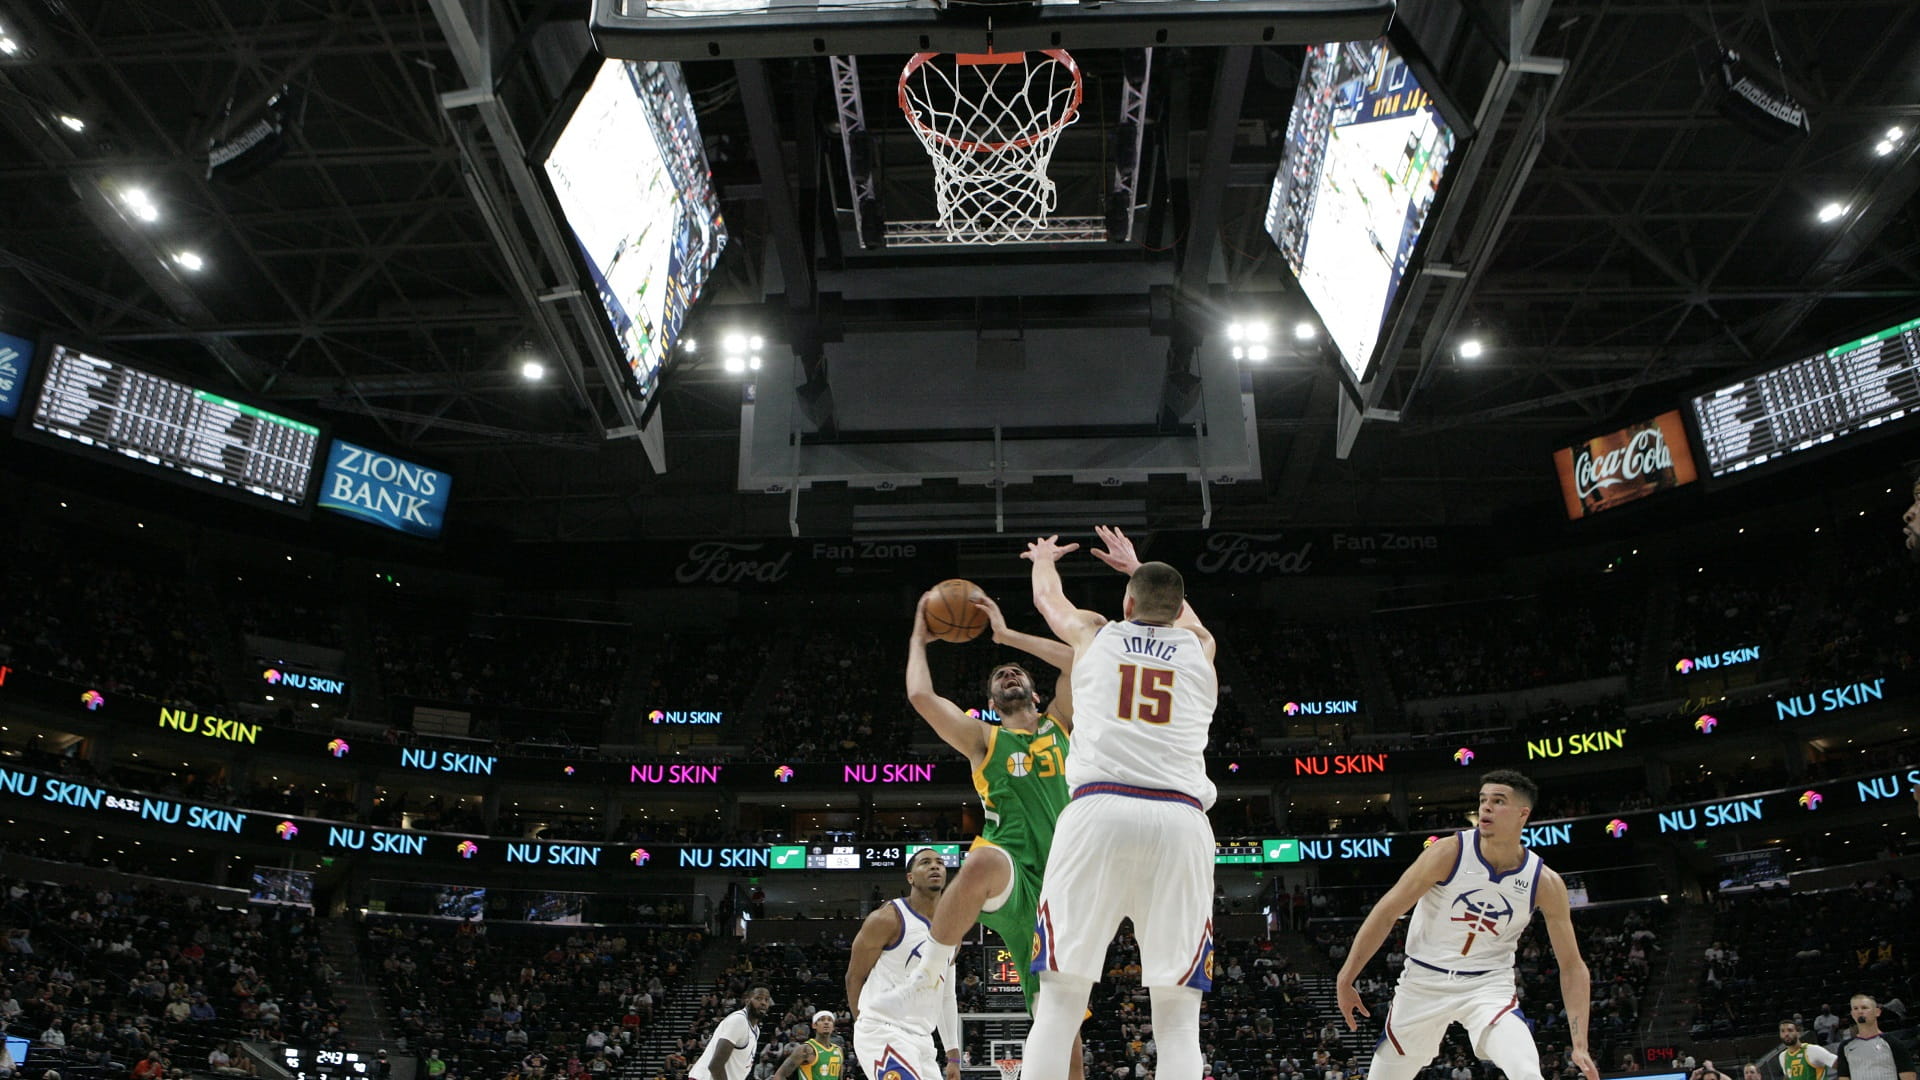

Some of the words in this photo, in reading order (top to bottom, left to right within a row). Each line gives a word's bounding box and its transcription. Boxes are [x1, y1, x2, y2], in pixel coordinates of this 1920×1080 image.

[336, 444, 437, 496] ZIONS
[1575, 429, 1673, 499] Coca-Cola
[330, 473, 430, 527] BANK
[812, 543, 854, 559] Fan
[860, 542, 917, 558] Zone
[1196, 532, 1312, 573] Ford
[1332, 534, 1374, 550] Fan
[1380, 533, 1438, 549] Zone
[675, 542, 792, 583] Ford
[1123, 634, 1177, 661] JOKIĆ
[1695, 654, 1719, 670] NU
[1722, 646, 1759, 665] SKIN
[283, 673, 306, 688] NU
[308, 677, 344, 694] SKIN
[1117, 663, 1175, 726] 15
[1301, 702, 1322, 714] NU
[1325, 701, 1357, 713] SKIN
[1776, 694, 1816, 720] NU
[1822, 679, 1884, 710] SKIN
[160, 708, 198, 732] NU
[202, 716, 258, 744] SKIN
[666, 712, 687, 723] NU
[690, 712, 721, 723] SKIN
[1528, 738, 1563, 759] NU
[1569, 729, 1625, 754] SKIN
[402, 748, 436, 769] NU
[441, 752, 495, 774] SKIN
[631, 765, 663, 783] NU
[669, 765, 719, 783] SKIN
[845, 765, 876, 782] NU
[883, 764, 933, 782] SKIN
[1035, 746, 1066, 777] 31
[1295, 757, 1328, 775] NU
[1334, 754, 1386, 774] SKIN
[0, 769, 37, 796] NU
[43, 780, 102, 809] SKIN
[1857, 776, 1899, 802] NU
[142, 799, 181, 823] NU
[187, 806, 243, 833] SKIN
[1659, 809, 1696, 832] NU
[1704, 799, 1763, 826] SKIN
[329, 827, 365, 849] NU
[371, 832, 425, 855] SKIN
[866, 848, 900, 859] 2:43
[1300, 840, 1332, 859] NU
[1340, 838, 1391, 858] SKIN
[507, 844, 541, 863] NU
[548, 845, 599, 865] SKIN
[680, 849, 712, 867] NU
[720, 849, 769, 867] SKIN
[1515, 879, 1529, 889] WU
